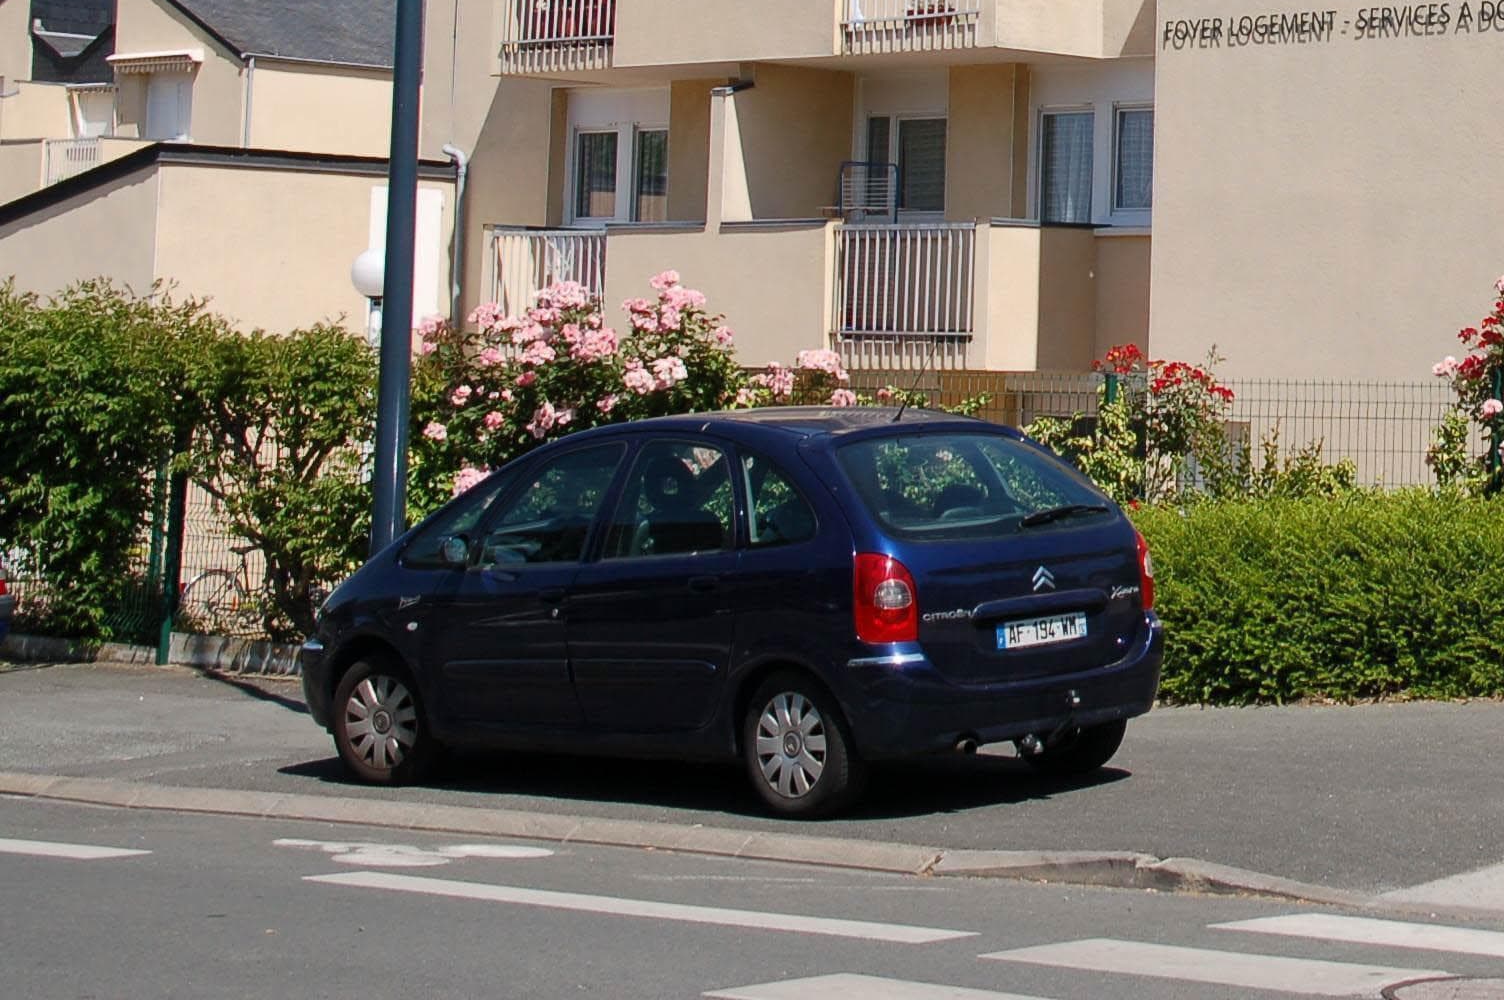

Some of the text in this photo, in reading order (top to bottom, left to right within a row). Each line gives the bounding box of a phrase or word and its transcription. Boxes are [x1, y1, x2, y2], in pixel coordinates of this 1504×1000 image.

[1165, 18, 1223, 41] FOYER
[1230, 10, 1337, 37] LOGEMENT
[1358, 2, 1451, 30] SERVICES
